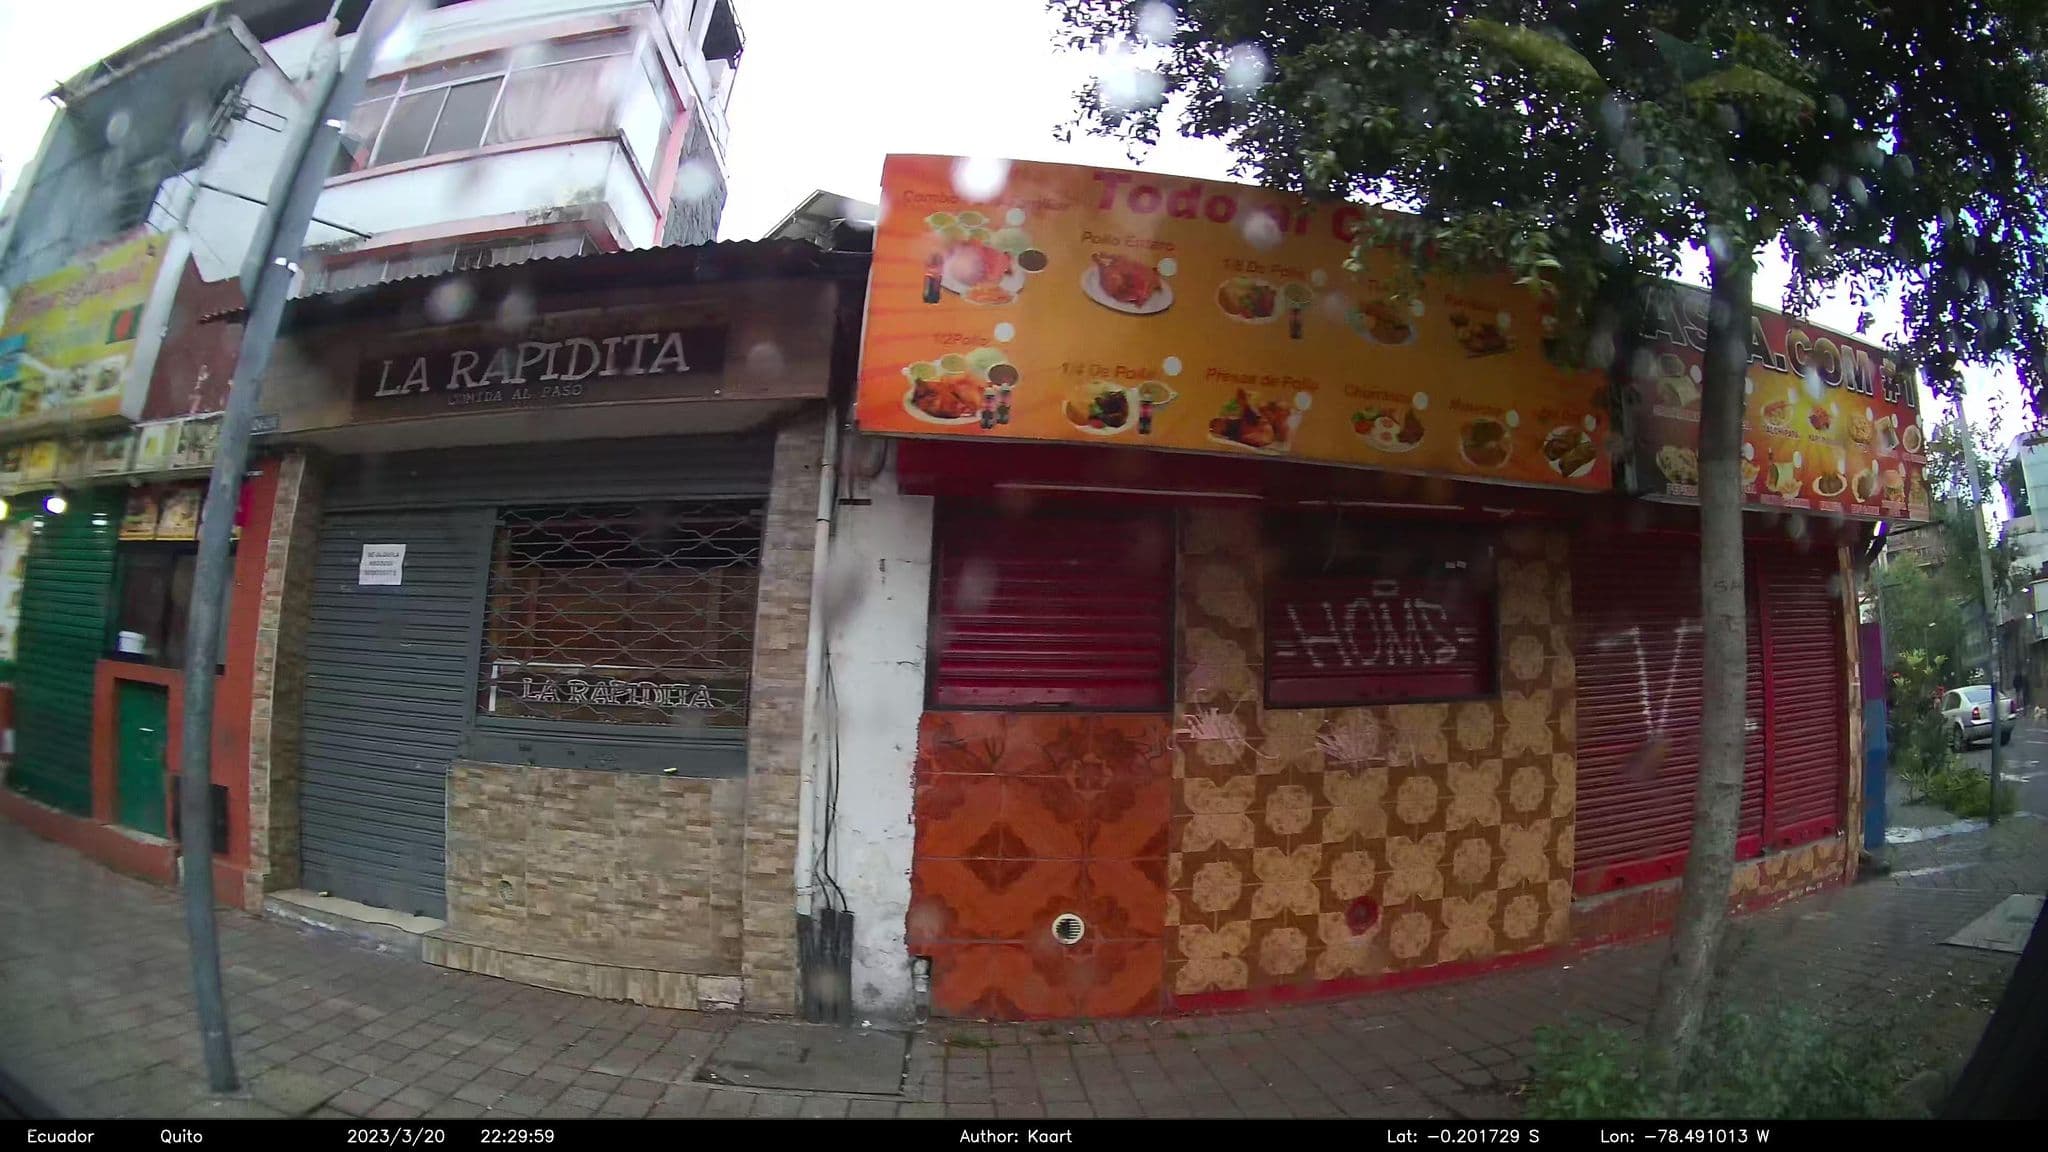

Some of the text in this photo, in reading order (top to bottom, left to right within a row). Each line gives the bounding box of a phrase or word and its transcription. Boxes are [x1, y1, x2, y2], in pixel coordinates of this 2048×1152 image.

[1093, 171, 1238, 224] Todo
[375, 332, 691, 397] LA RAPIDITA
[542, 383, 584, 398] PASO
[521, 676, 562, 703] LA
